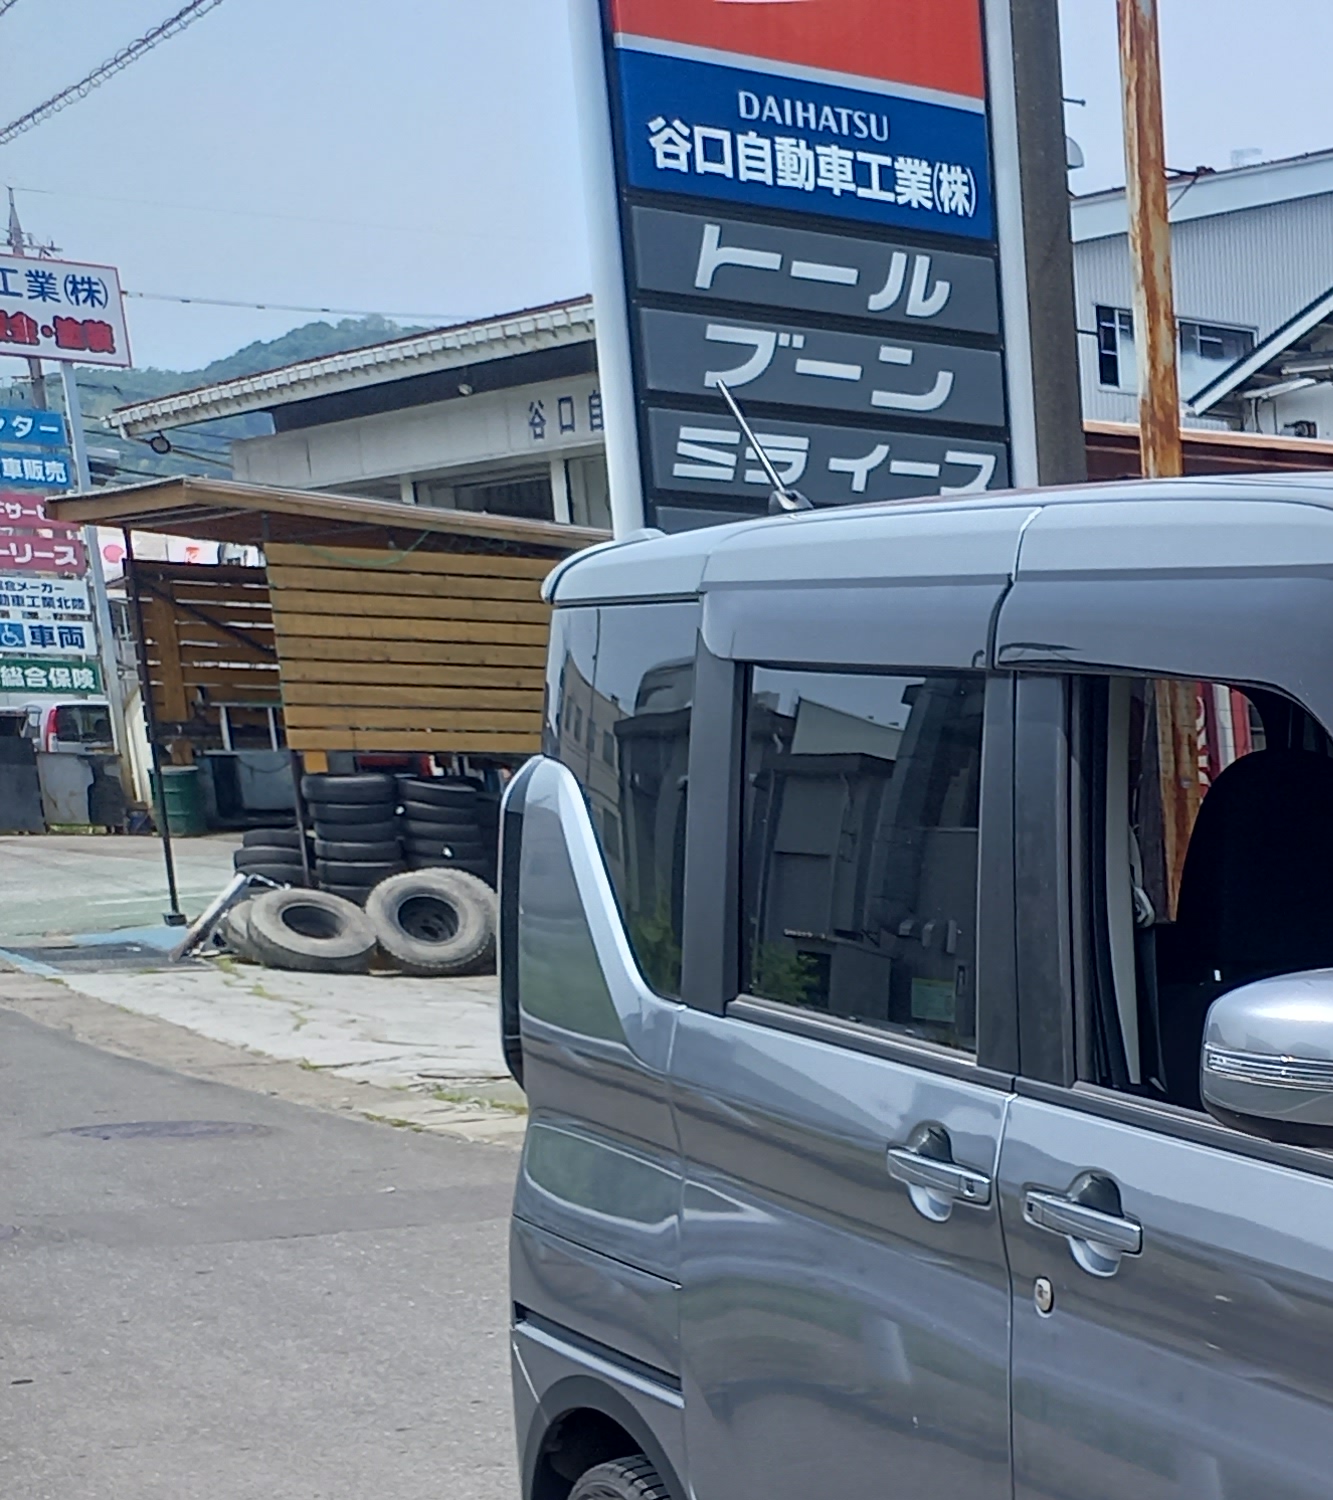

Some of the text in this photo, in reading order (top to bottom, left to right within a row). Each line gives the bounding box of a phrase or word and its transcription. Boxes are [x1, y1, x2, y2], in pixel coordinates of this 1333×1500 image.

[738, 90, 889, 142] DAIHATSU
[694, 224, 951, 318] トール
[703, 323, 953, 412] ブーン
[0, 415, 59, 438] ター
[28, 624, 86, 650] 車両
